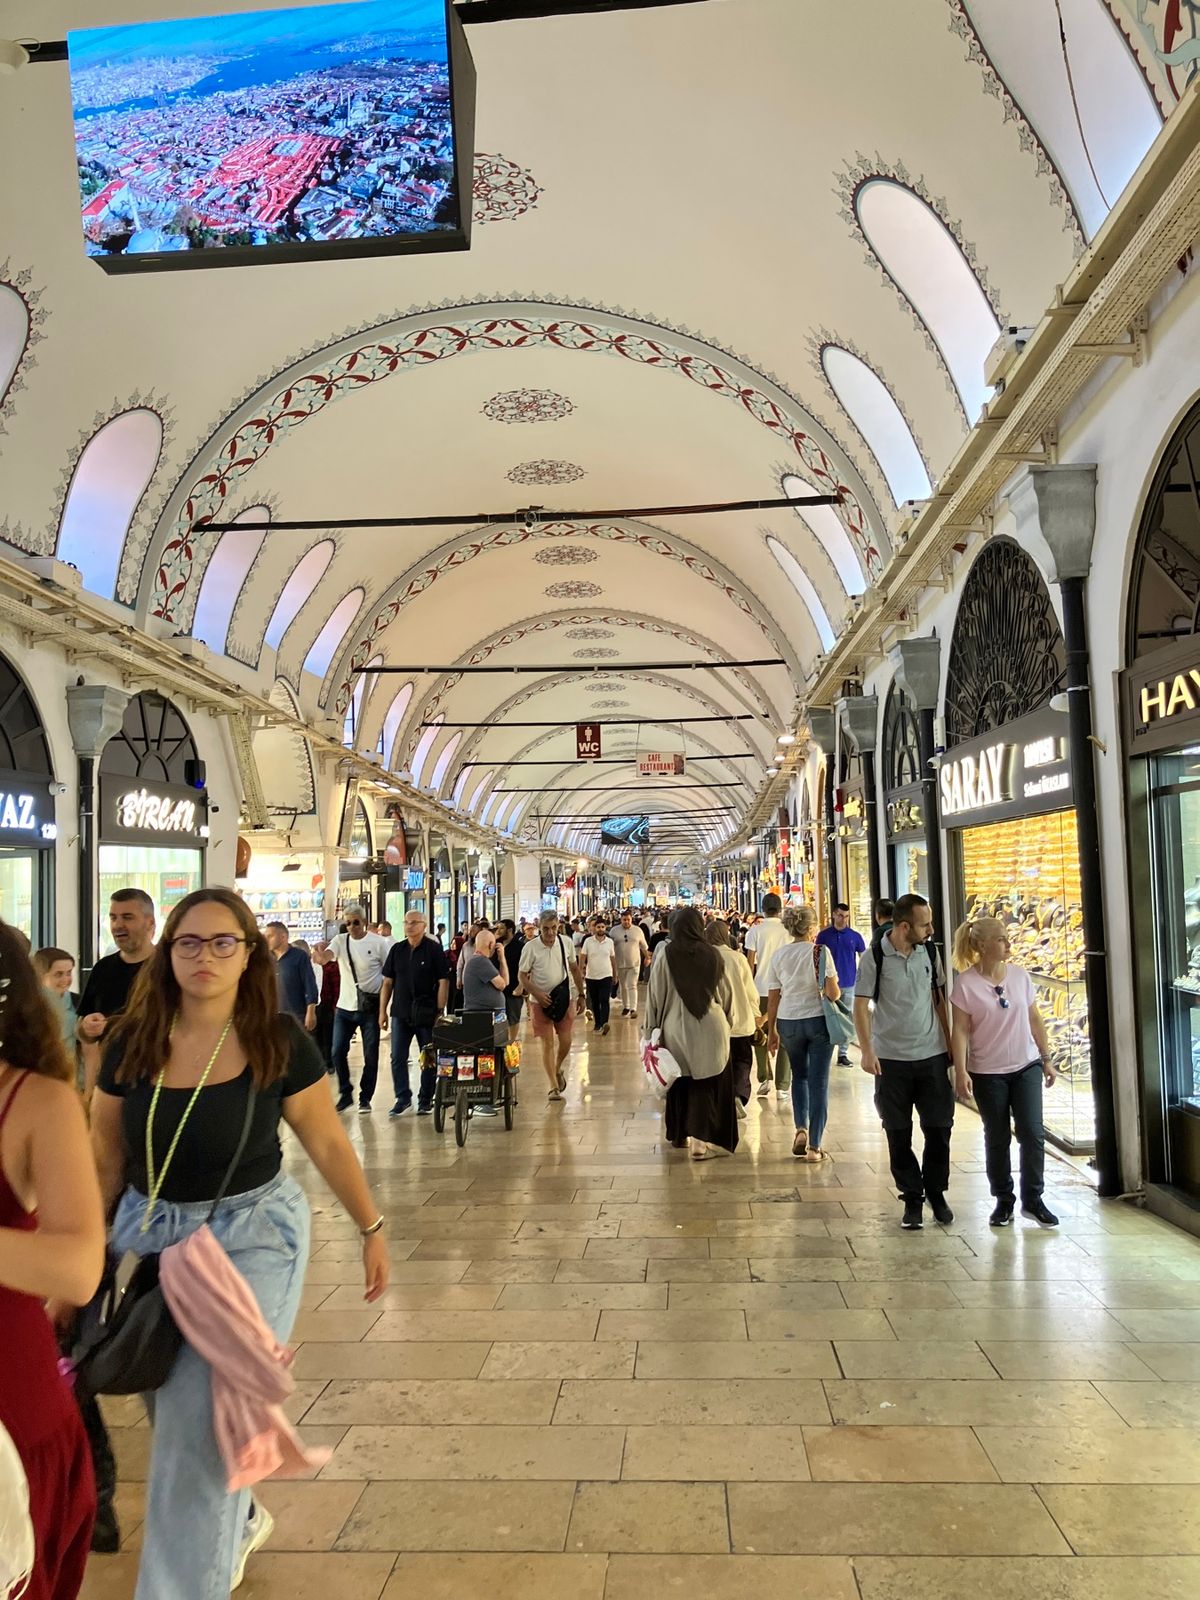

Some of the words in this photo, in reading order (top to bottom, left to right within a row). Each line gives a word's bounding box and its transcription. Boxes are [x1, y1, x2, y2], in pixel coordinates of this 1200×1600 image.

[579, 742, 599, 752] WC
[648, 754, 661, 762] CAFE
[640, 763, 674, 771] RESTAURANT
[940, 743, 1005, 816] SARAY
